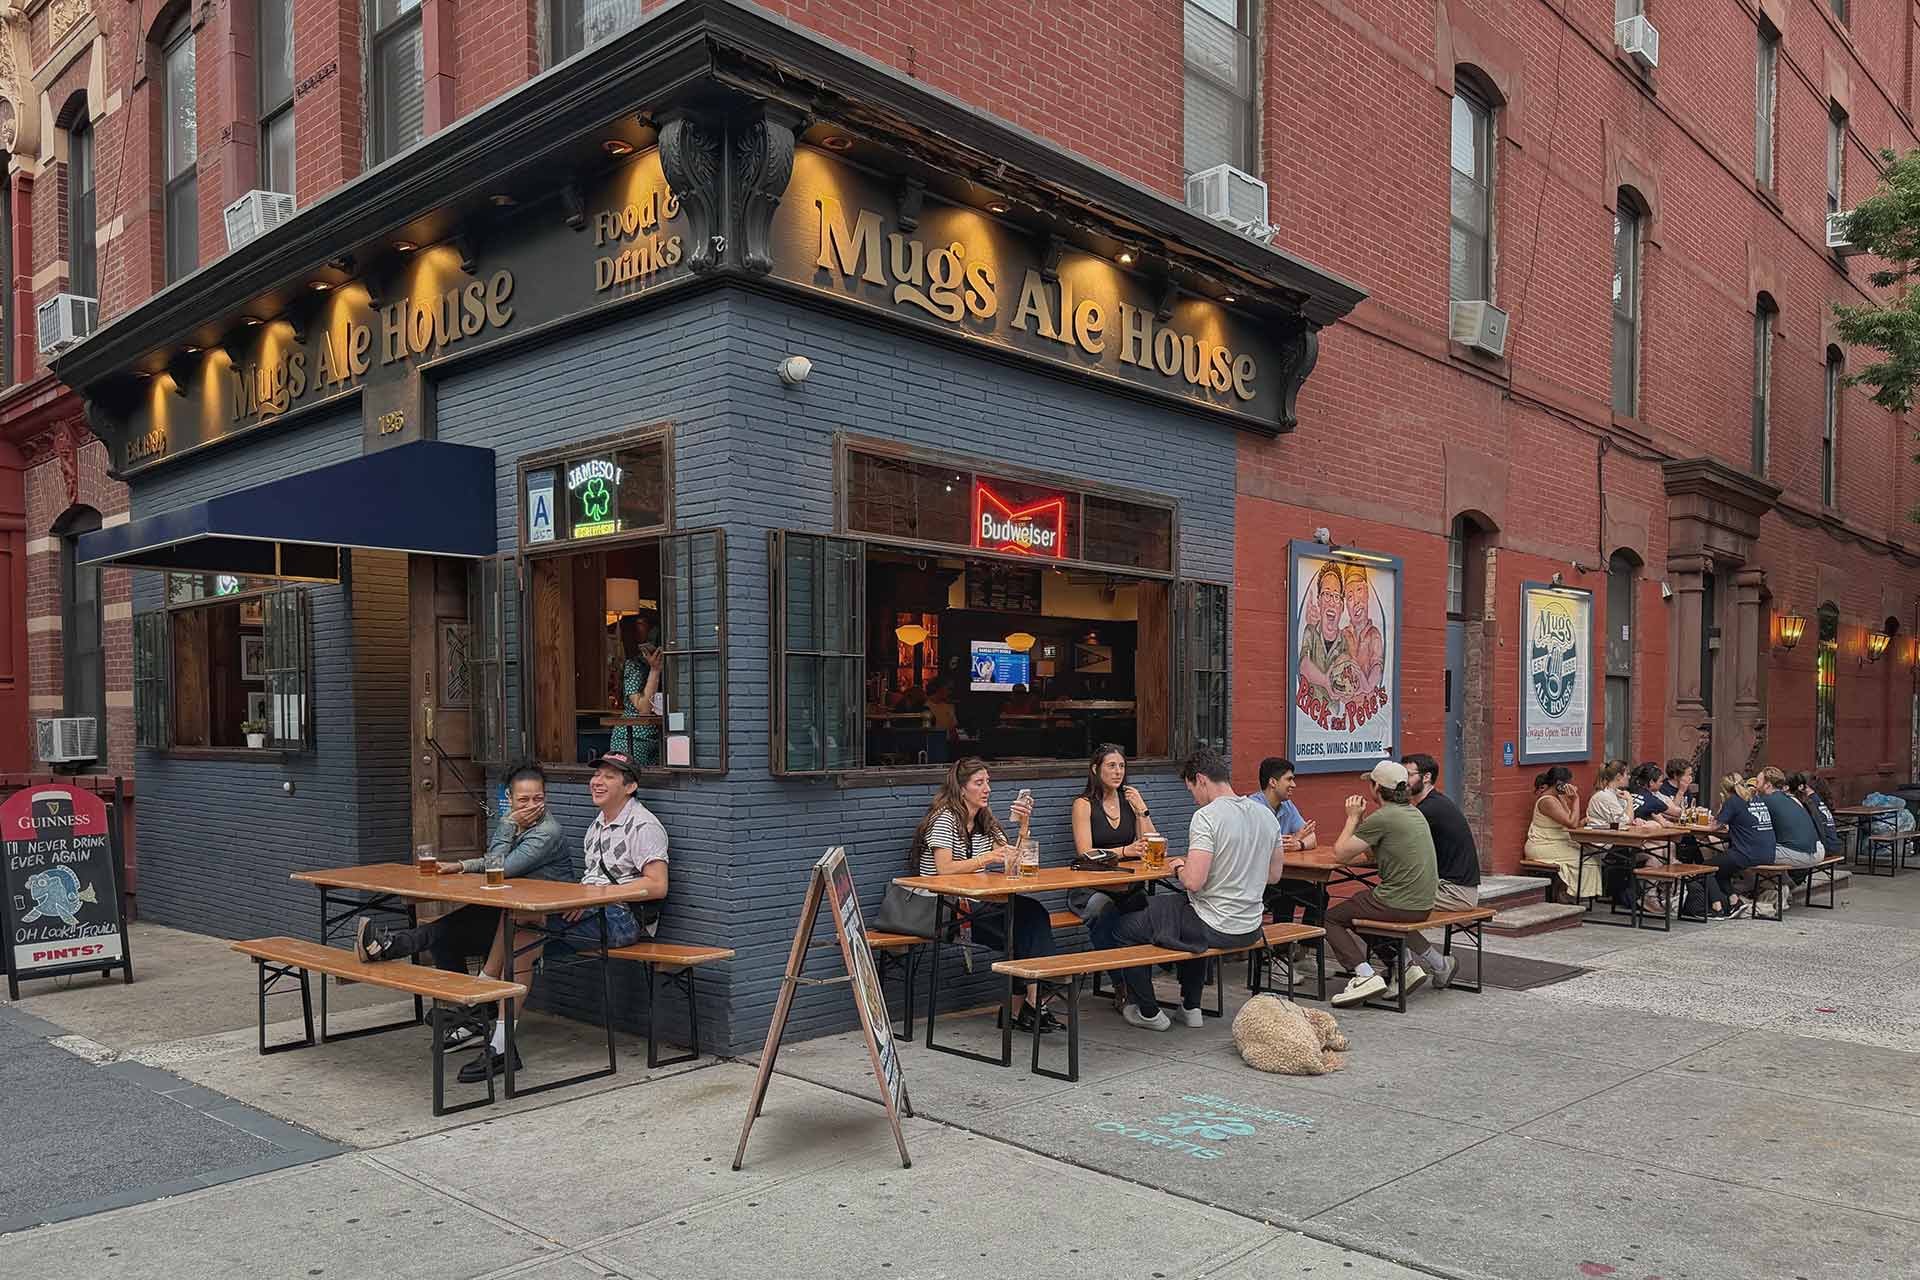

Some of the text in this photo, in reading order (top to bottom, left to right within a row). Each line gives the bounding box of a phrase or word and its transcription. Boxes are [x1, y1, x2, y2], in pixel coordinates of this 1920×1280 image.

[593, 190, 660, 247] Food
[594, 234, 682, 291] Drinks
[312, 319, 372, 391] Ale
[380, 268, 514, 366] House
[1009, 267, 1106, 354] Ale
[1118, 299, 1258, 400] House
[533, 495, 550, 528] A
[981, 512, 1057, 548] Budweiser
[1296, 674, 1388, 734] Rick and Pete's
[1535, 680, 1573, 713] ALE HOUSE
[1296, 740, 1382, 757] URGERS, WINGS AND MORE
[17, 813, 91, 830] GUINNESS
[10, 854, 46, 871] EVER
[27, 839, 68, 855] NEVER
[15, 927, 38, 944] OH
[32, 943, 104, 962] PINTS?
